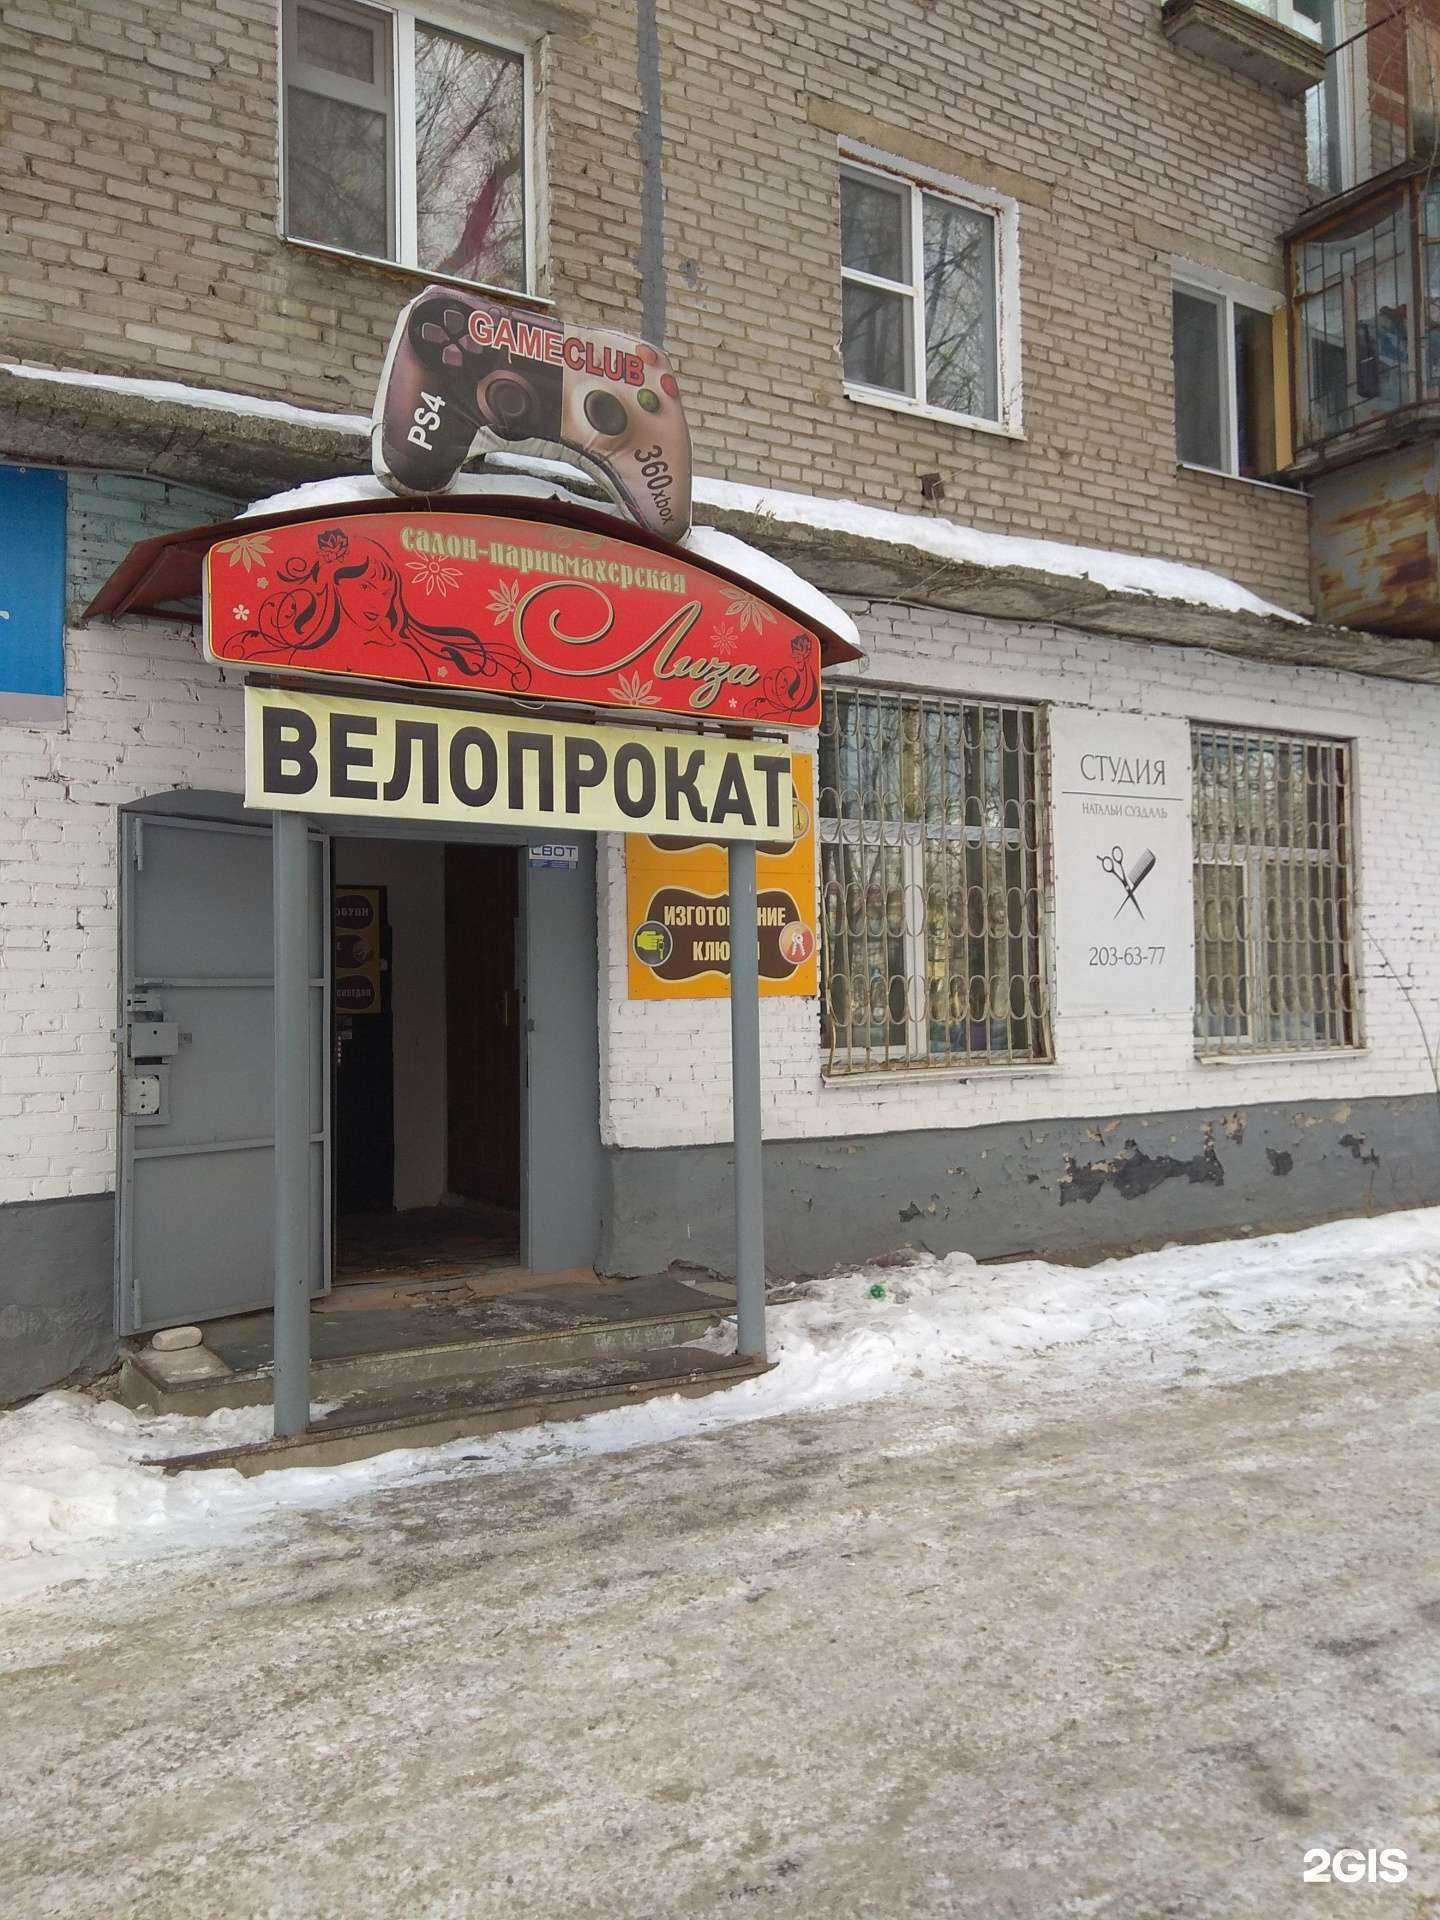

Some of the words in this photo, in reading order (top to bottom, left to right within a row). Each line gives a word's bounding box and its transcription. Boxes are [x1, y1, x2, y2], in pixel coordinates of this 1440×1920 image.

[468, 310, 645, 386] GAMECLUB
[407, 391, 445, 451] PS4
[513, 579, 760, 709] Лиза
[262, 706, 791, 827] ВЕЛОПРОКАТ
[1080, 754, 1166, 785] СТУДИЯ
[1082, 801, 1122, 817] НАТАЛЬИ
[1125, 804, 1168, 819] СУЗДАЛЬ
[664, 905, 786, 927] ИЗГОТОНИЕ
[1088, 946, 1166, 966] 203-63-77
